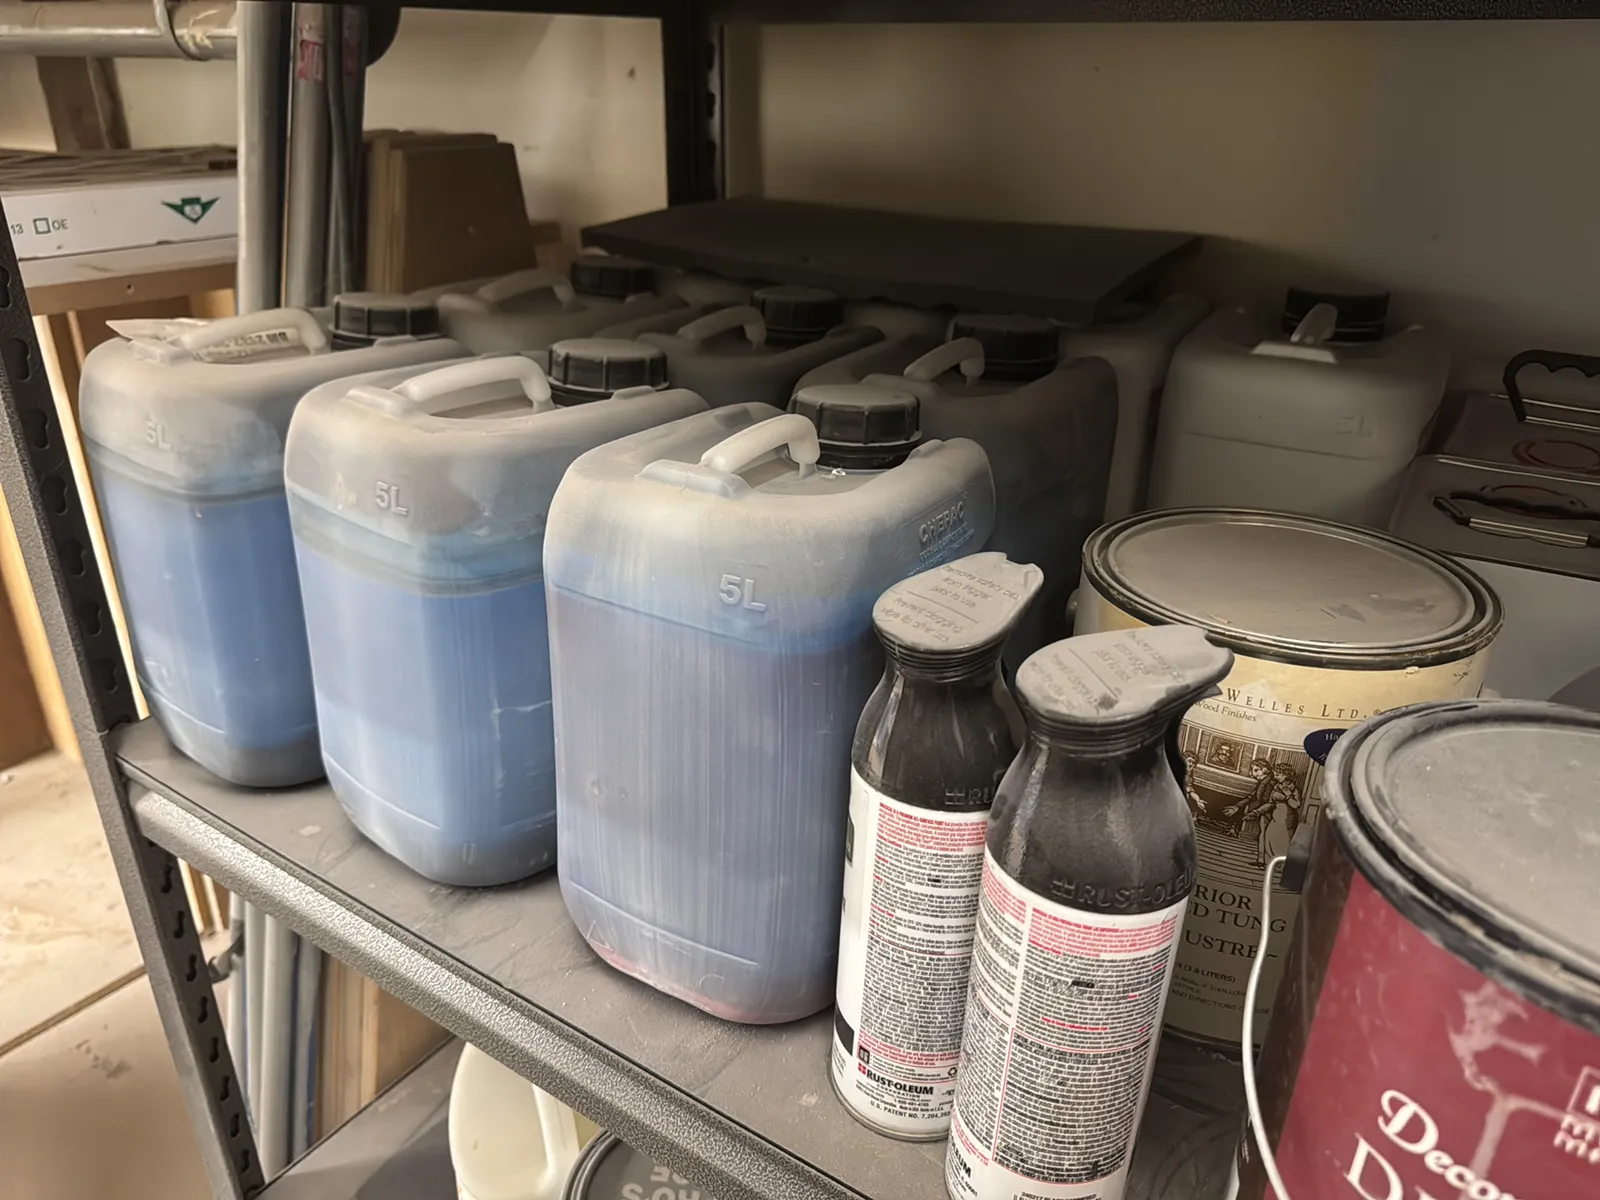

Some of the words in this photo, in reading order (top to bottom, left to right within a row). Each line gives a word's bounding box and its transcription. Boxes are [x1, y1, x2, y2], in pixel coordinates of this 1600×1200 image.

[52, 219, 69, 231] OE
[375, 481, 409, 517] 5L
[718, 573, 767, 612] 5L
[1195, 700, 1220, 715] Wood
[1221, 706, 1257, 723] Finishes
[1227, 688, 1305, 714] WELLES
[1194, 884, 1252, 911] RIOR
[1216, 908, 1287, 933] TUNG
[1185, 929, 1260, 960] USTRE
[866, 1069, 934, 1096] RUST-OLEUM
[883, 1105, 907, 1119] PATENT
